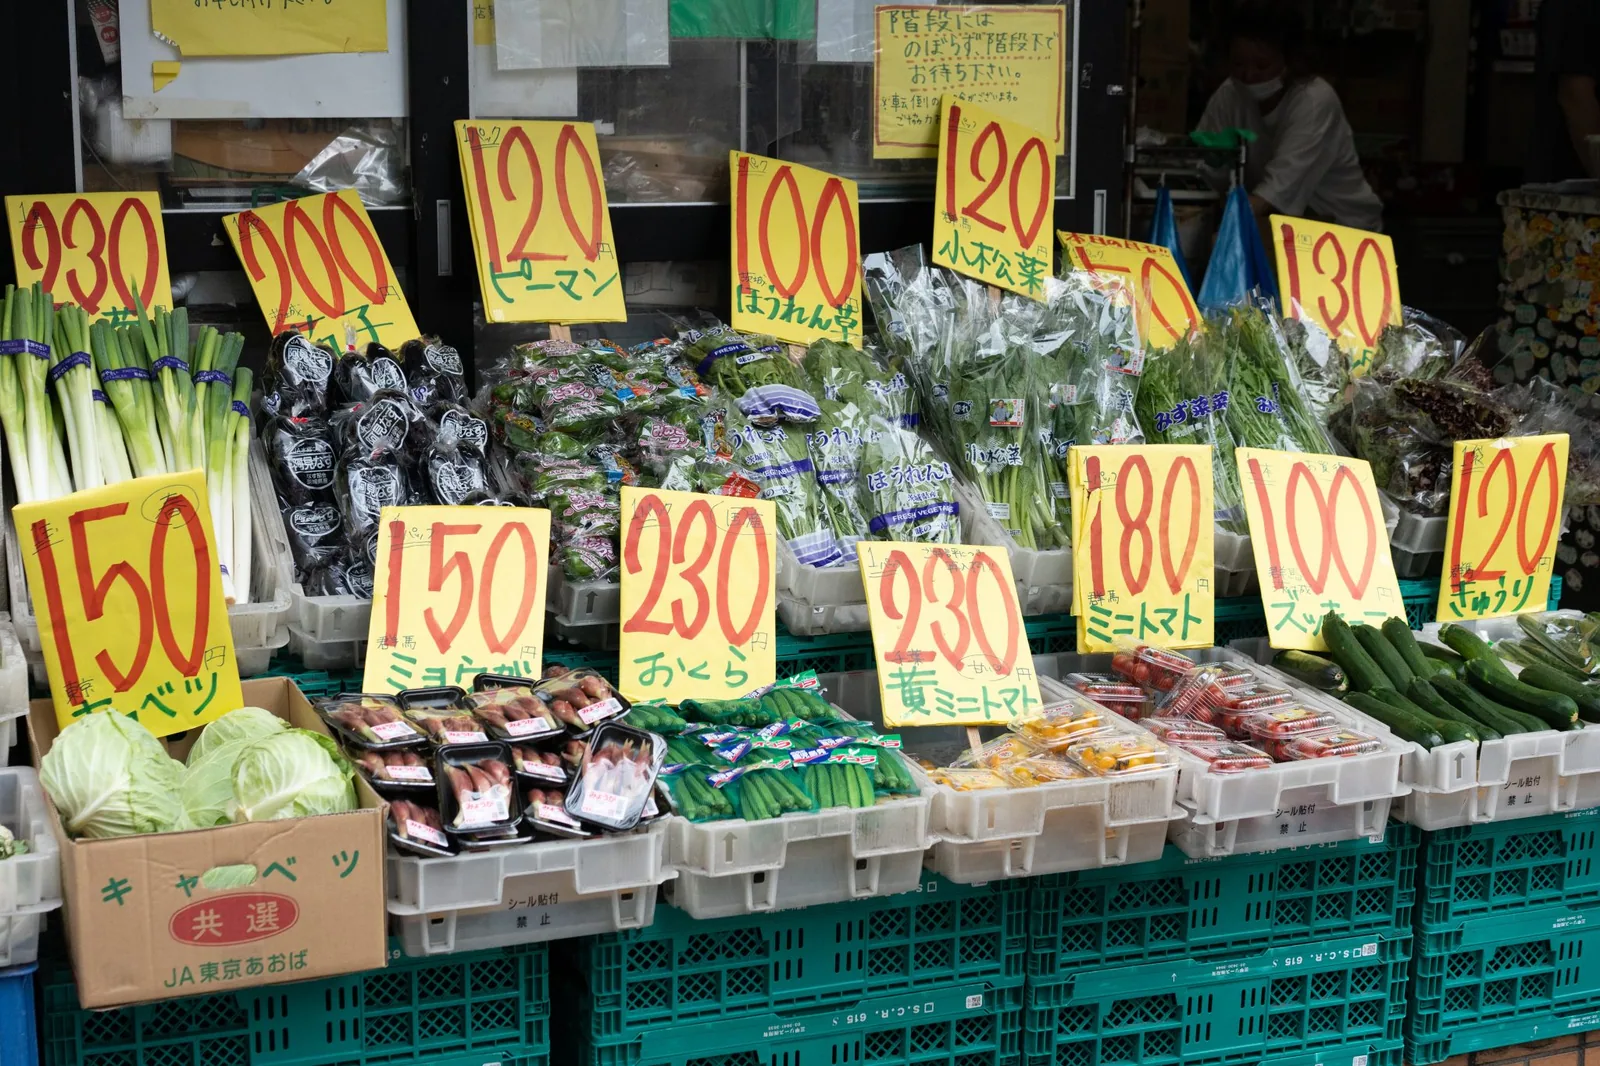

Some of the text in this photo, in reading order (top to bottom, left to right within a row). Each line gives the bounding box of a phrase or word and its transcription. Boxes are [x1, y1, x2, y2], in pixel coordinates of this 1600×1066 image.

[889, 10, 995, 34] 階段には
[904, 31, 1059, 59] のぼらず、階段下で
[908, 62, 1022, 85] お待ち下さい。
[467, 125, 602, 273] 120
[946, 105, 1050, 250] 120
[737, 157, 857, 308] 100
[22, 198, 159, 316] 230
[238, 192, 388, 336] 200
[938, 230, 1048, 294] 小松菜
[489, 258, 618, 303] ピーマン
[1281, 223, 1392, 348] 130
[736, 284, 859, 341] ほうれん草
[965, 443, 1023, 466] 小松菜
[892, 512, 917, 522] FRESH
[1086, 454, 1201, 597] 180
[1247, 458, 1377, 601] 100
[1450, 442, 1559, 593] 120
[385, 521, 538, 655] 150
[623, 493, 770, 647] 230
[32, 494, 211, 706] 150
[879, 549, 1020, 676] 230
[1086, 592, 1202, 643] ミニトマト
[1449, 575, 1535, 618] きゅうり
[634, 645, 749, 689] おくら
[886, 665, 1038, 720] 黄ミニトマト
[1504, 775, 1541, 790] シール貼付
[1507, 793, 1533, 806] 禁止
[1275, 802, 1316, 819] シール貼付
[1279, 822, 1308, 835] 禁止
[101, 849, 360, 906] キャベツ
[191, 901, 281, 940] 共選
[509, 893, 559, 910] シール貼付
[516, 914, 551, 929] 禁止
[164, 948, 309, 988] JA東京あおば
[1284, 954, 1304, 966] 615
[1313, 949, 1351, 963] S.C.R.
[846, 1012, 867, 1024] 615
[875, 1005, 920, 1019] S.C.R.
